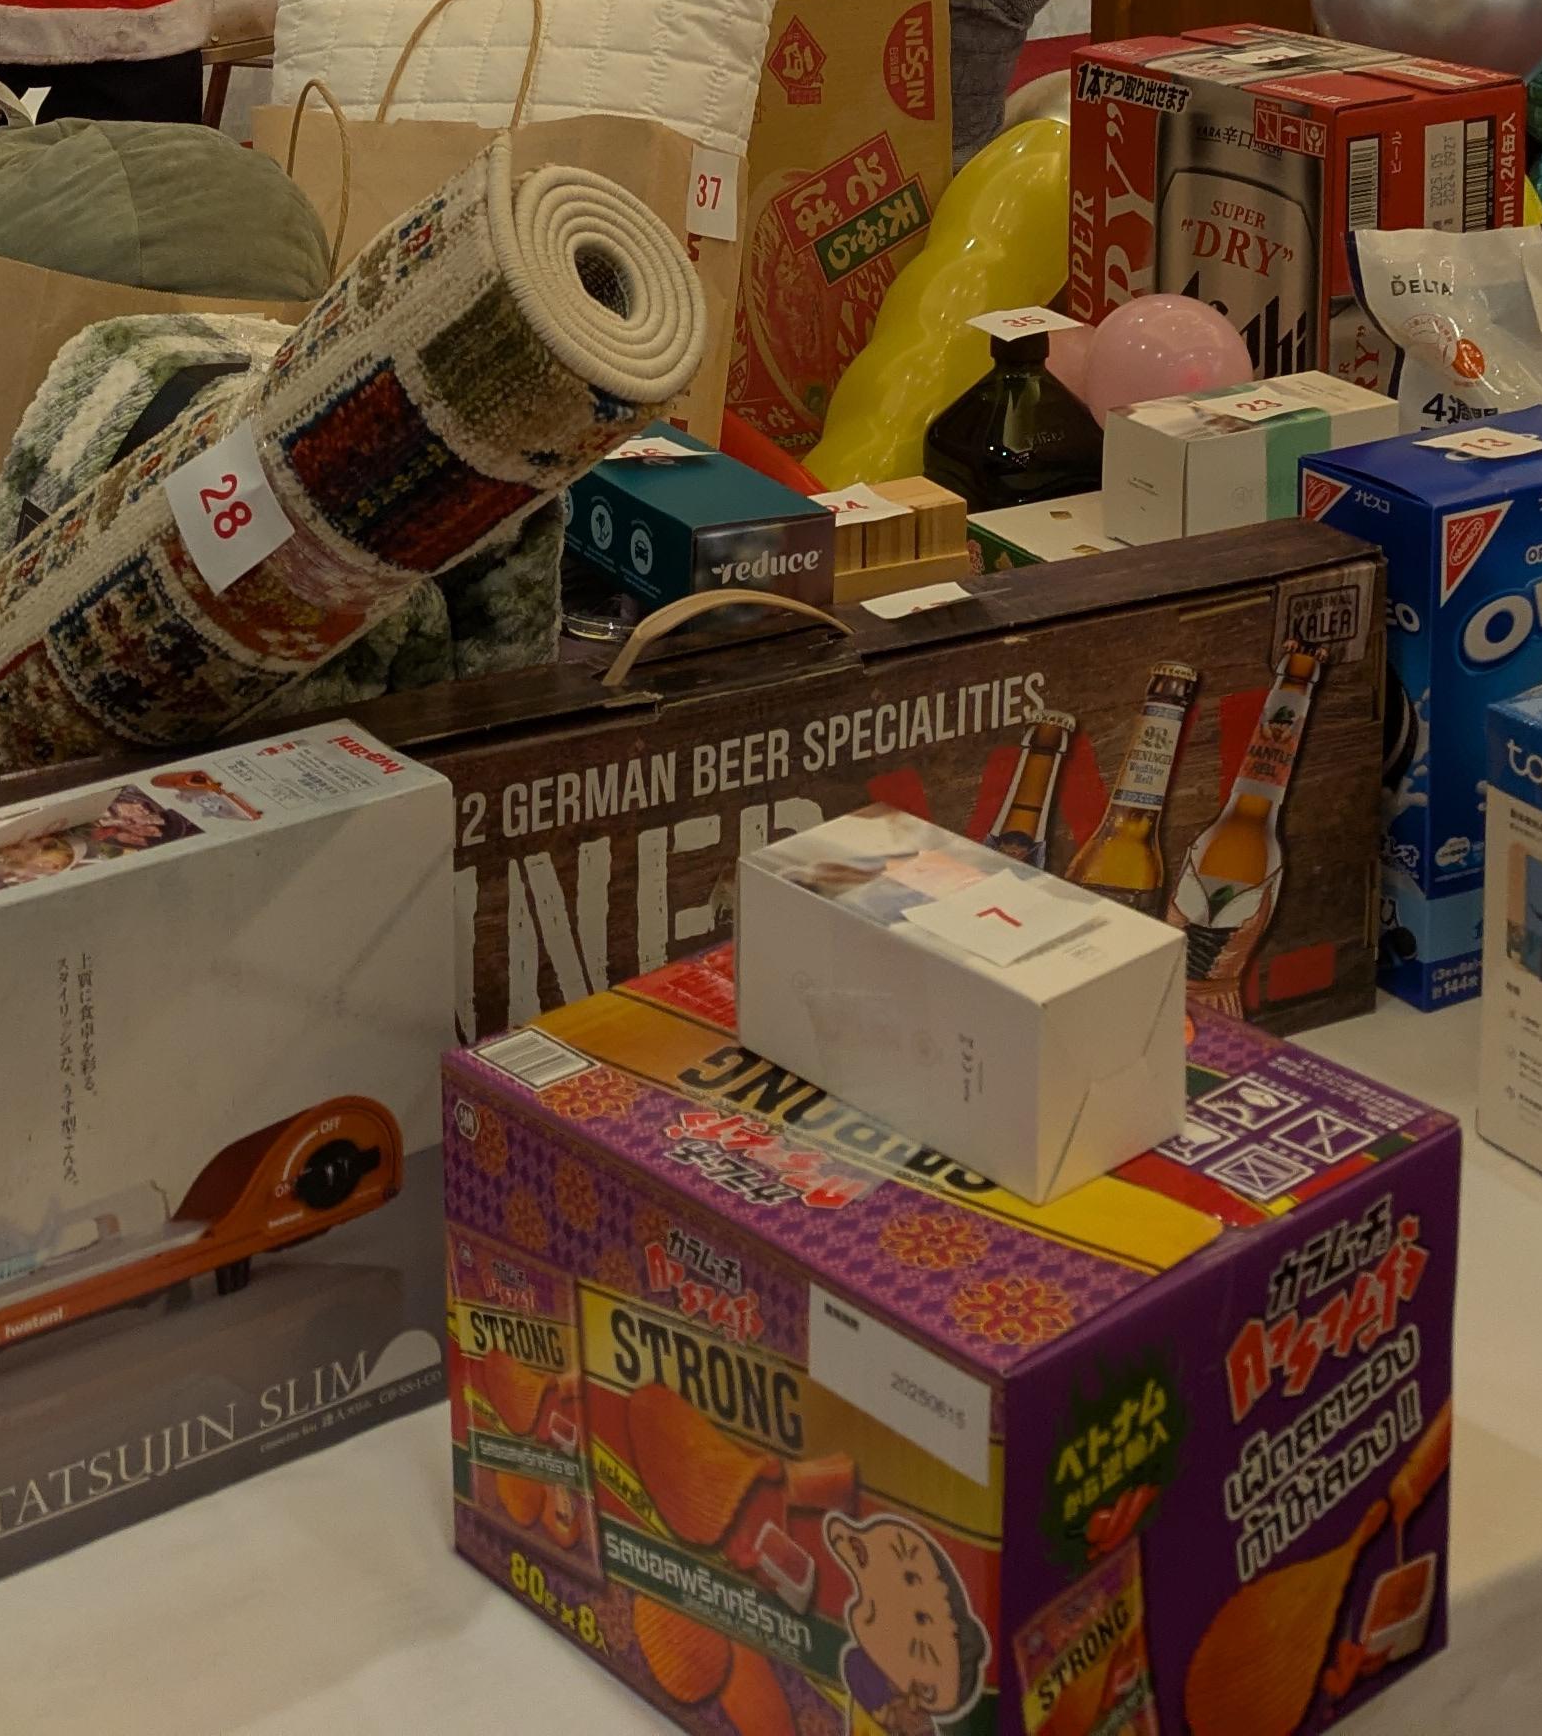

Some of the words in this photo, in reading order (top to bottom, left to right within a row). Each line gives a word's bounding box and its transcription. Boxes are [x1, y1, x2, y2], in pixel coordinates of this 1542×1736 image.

[903, 14, 926, 110] NISSIN
[1075, 62, 1191, 113] 1本ずつ取り出せます
[1222, 125, 1252, 150] 辛口
[1389, 131, 1402, 175] ビール
[695, 175, 722, 211] 37
[1210, 199, 1266, 230] SUPER
[1235, 398, 1283, 412] 23
[199, 473, 253, 541] 28
[1354, 488, 1391, 514] ナビスコ
[711, 549, 820, 585] reduce
[1292, 609, 1352, 641] KALEA
[326, 735, 405, 775] Iwatani
[502, 751, 676, 836] GERMAN
[688, 727, 789, 796] BEER
[801, 671, 1049, 768] SPECIALITIES
[320, 1116, 341, 1134] OFF
[469, 1310, 565, 1369] STRONG
[259, 1350, 368, 1429] SLIM
[610, 1308, 805, 1454] STRONG
[1038, 1590, 1132, 1713] STRONG
